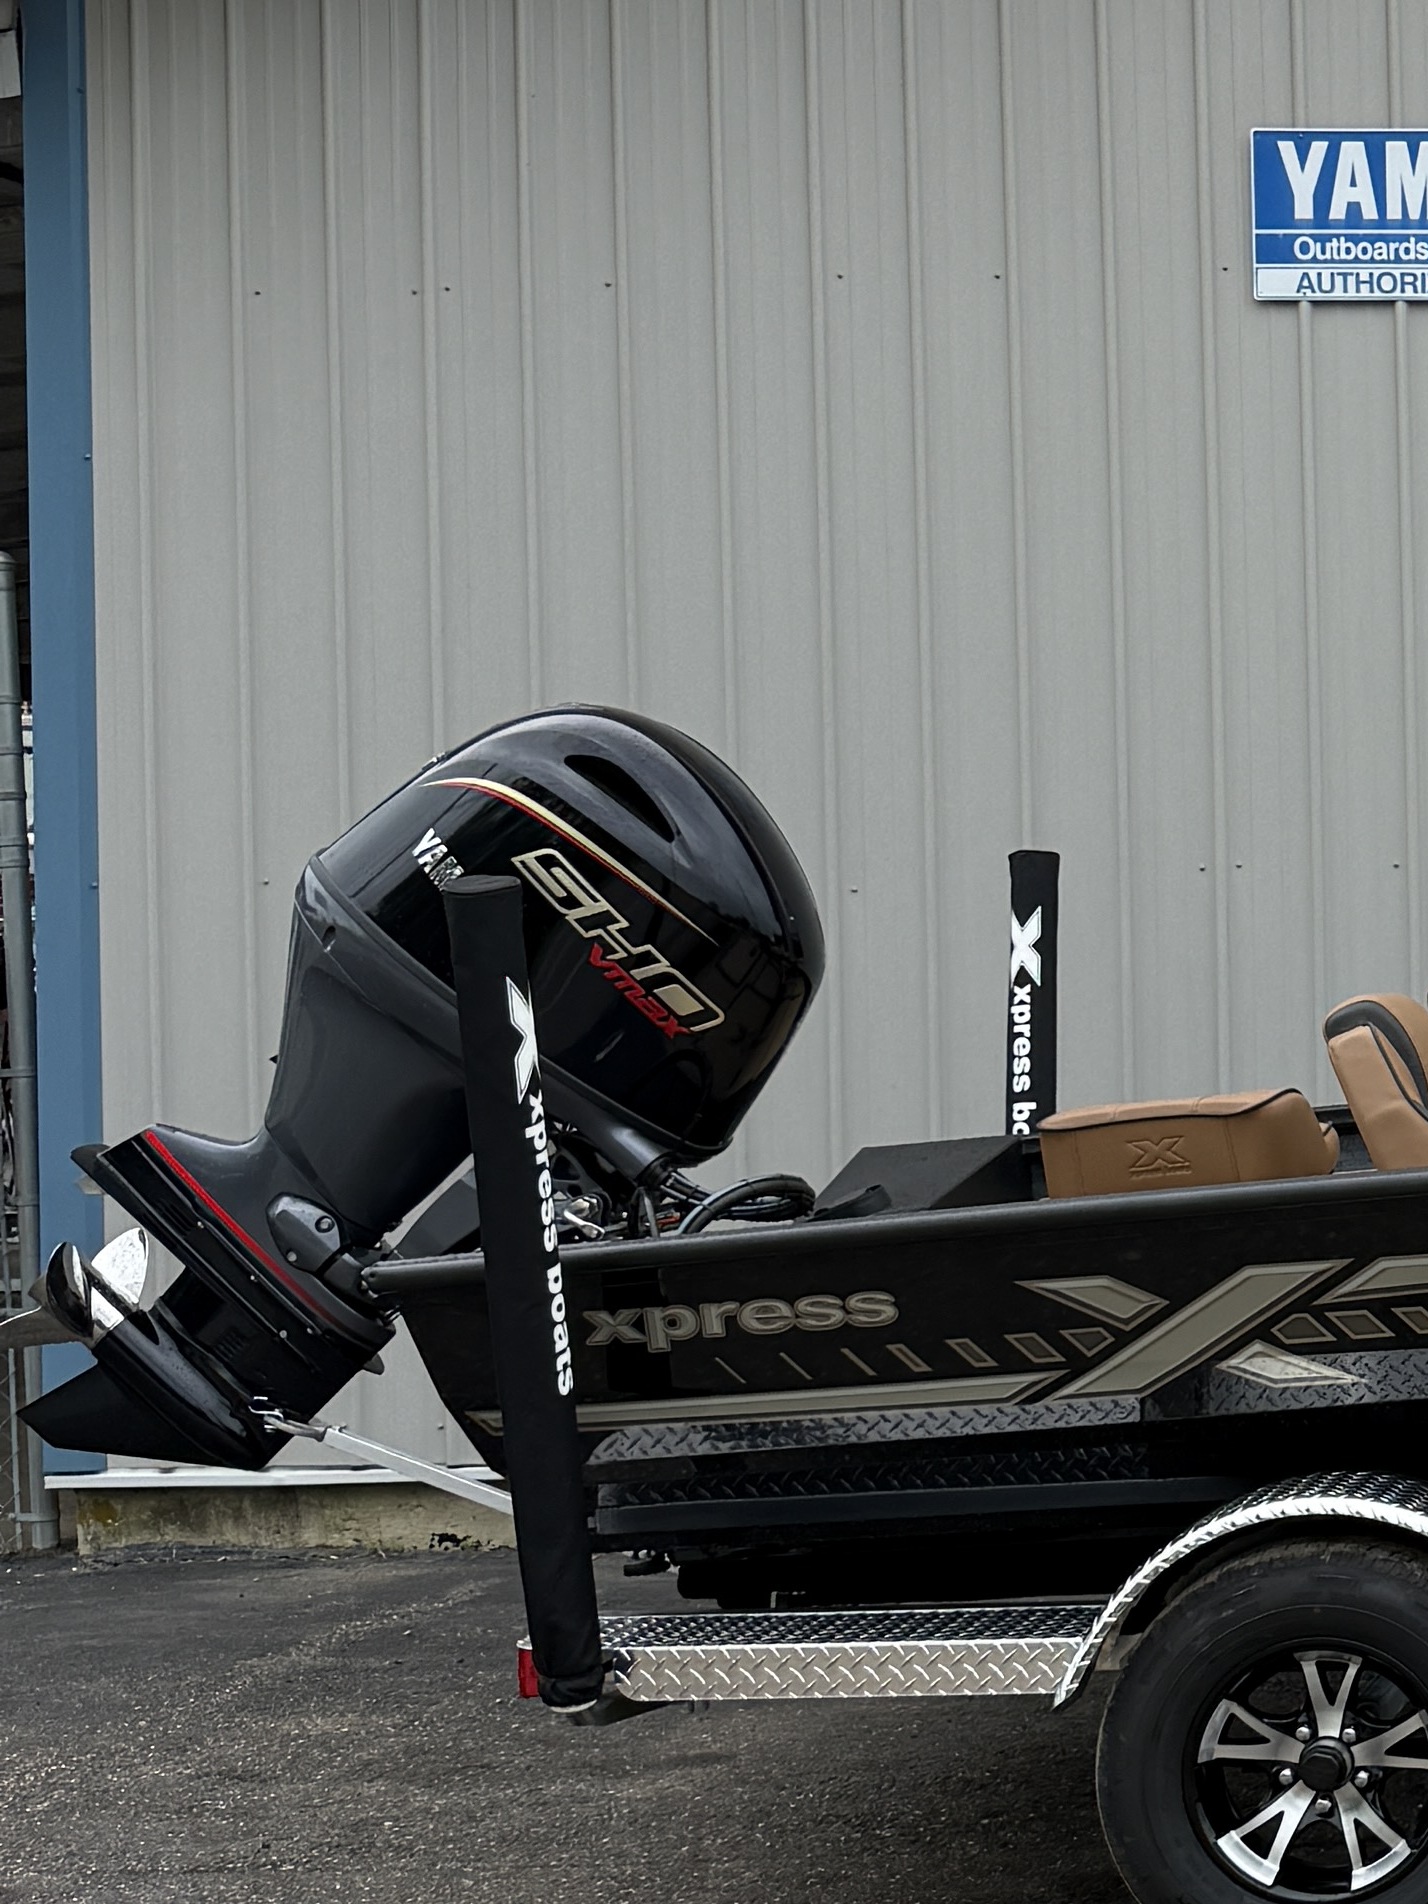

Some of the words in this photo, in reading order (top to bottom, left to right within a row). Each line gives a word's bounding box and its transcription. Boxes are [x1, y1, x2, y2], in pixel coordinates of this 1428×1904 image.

[511, 848, 725, 1033] SHO
[1010, 983, 1032, 1094] xpress
[525, 1089, 559, 1254] xpress
[582, 1290, 900, 1354] xpress
